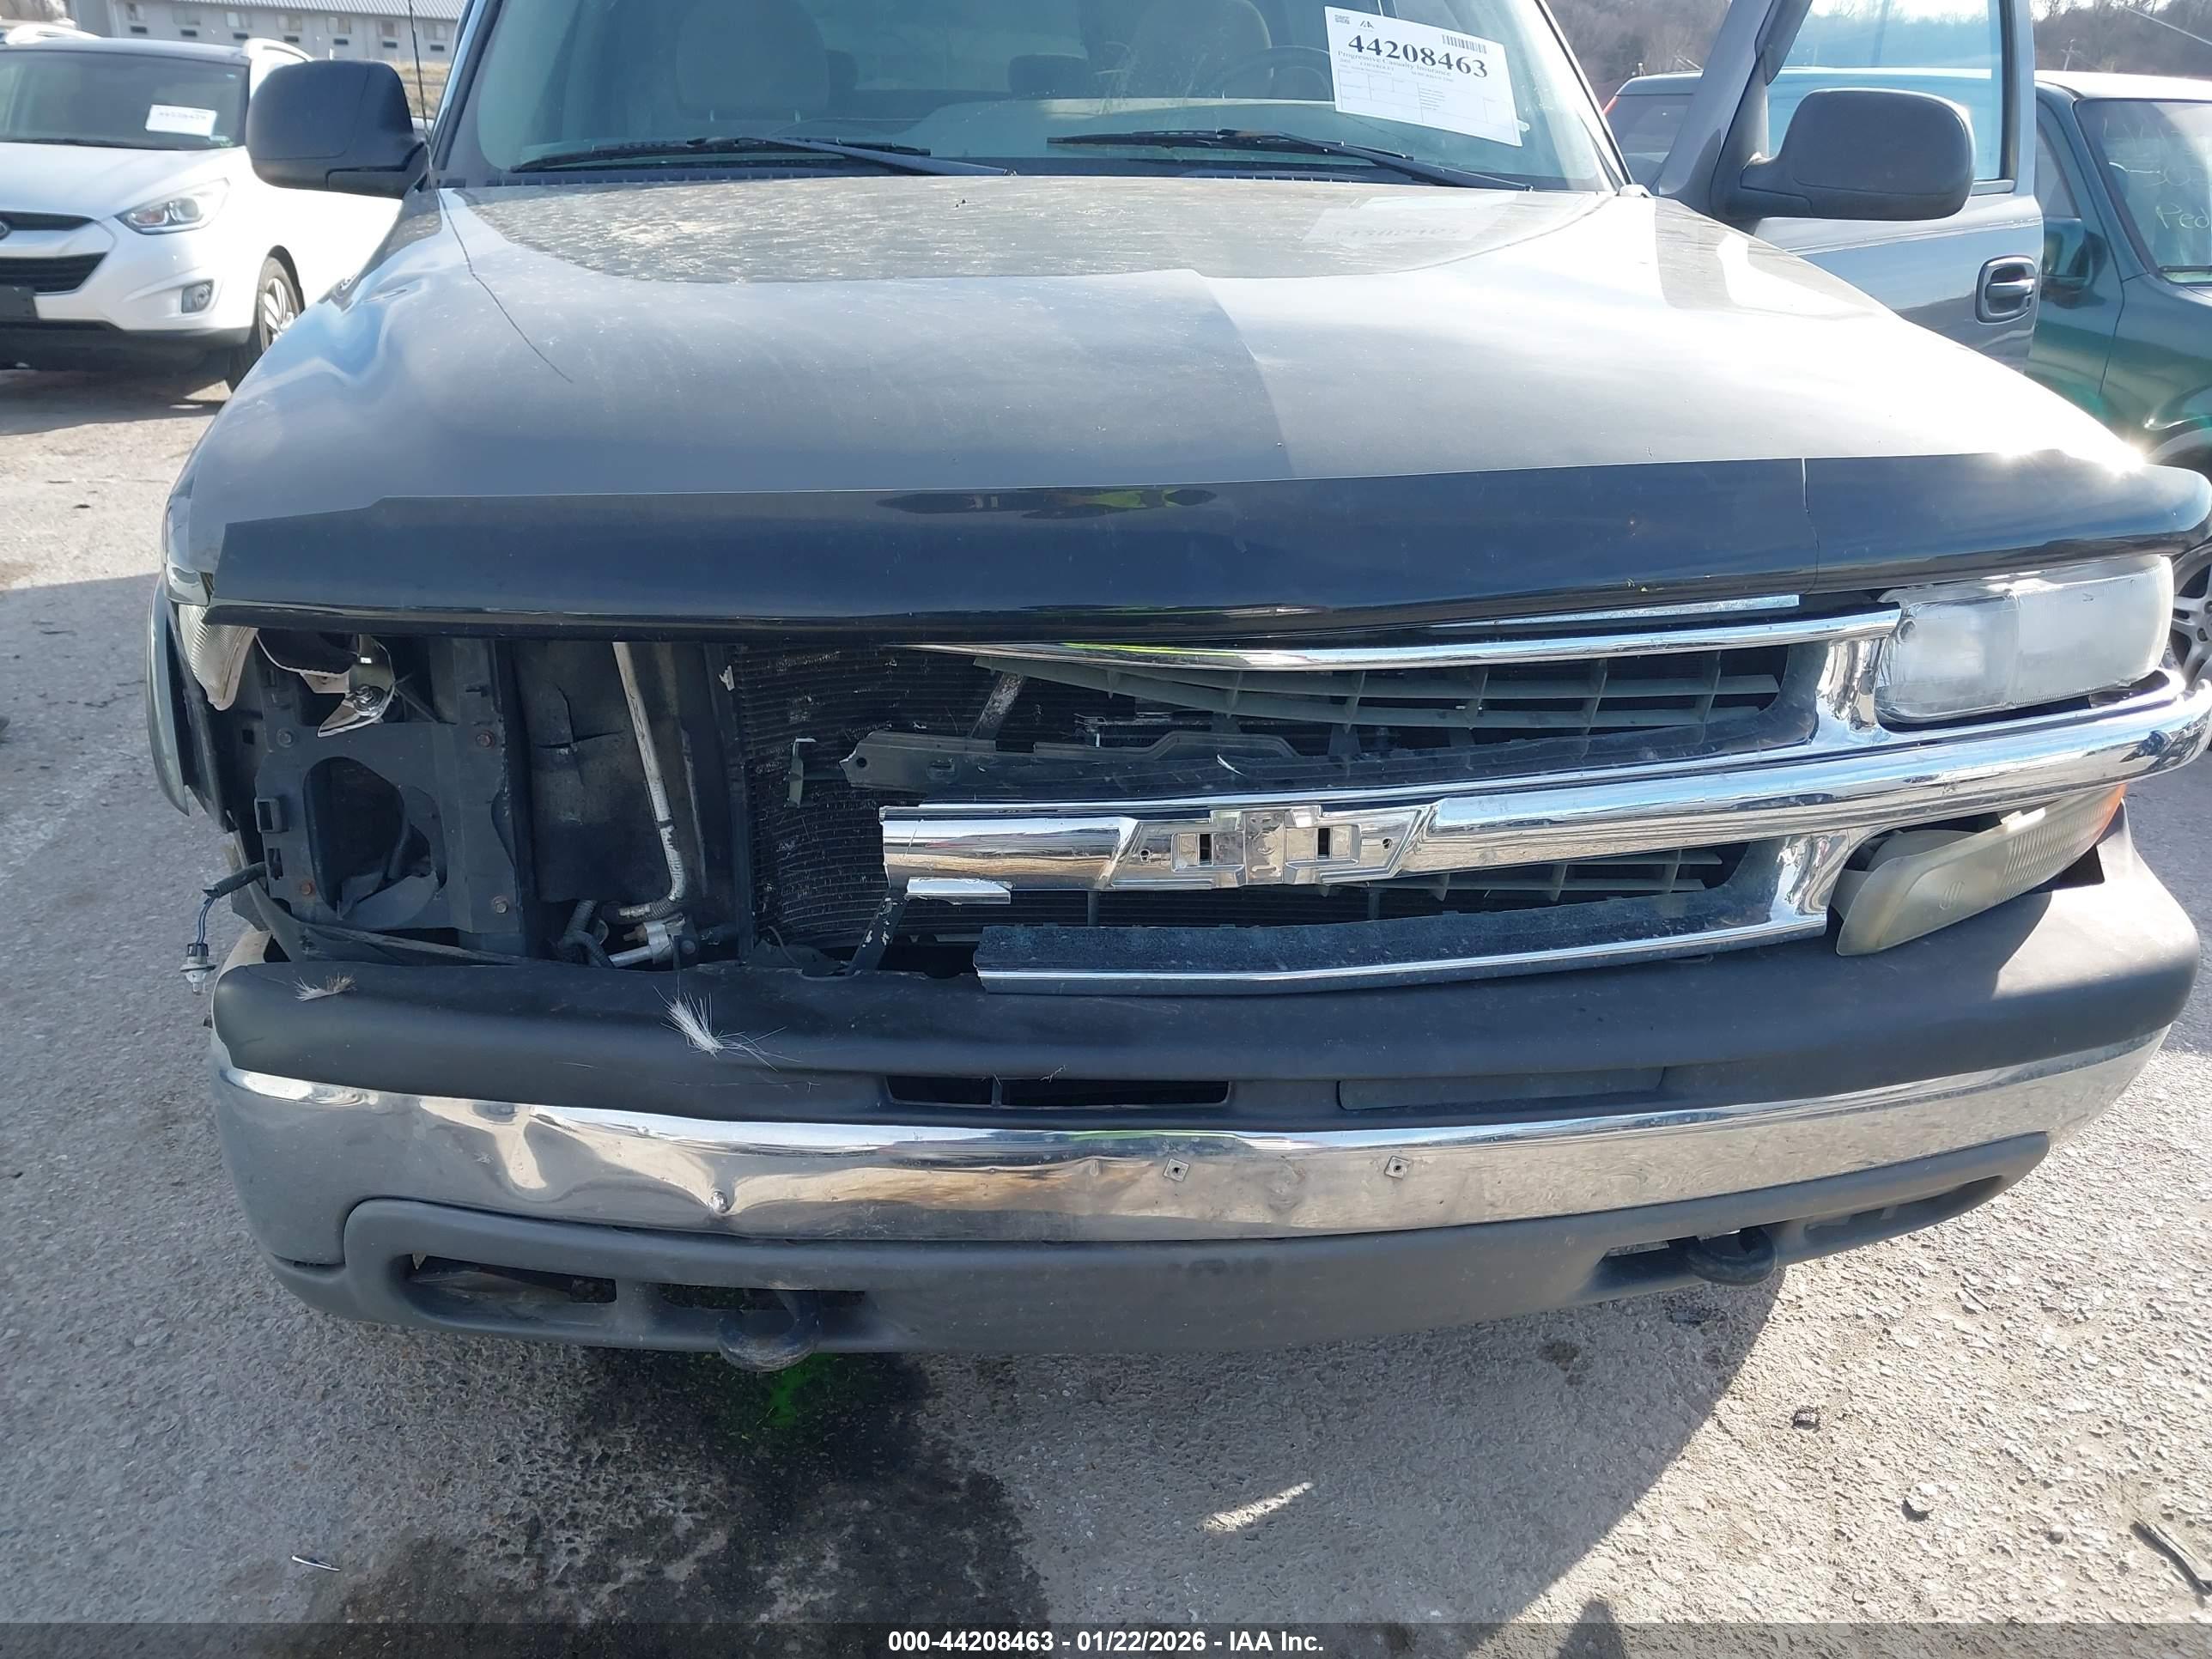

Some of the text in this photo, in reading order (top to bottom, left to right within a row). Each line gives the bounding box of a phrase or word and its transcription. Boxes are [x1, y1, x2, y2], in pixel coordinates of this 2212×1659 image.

[1338, 51, 1382, 64] Progressive
[1417, 64, 1451, 76] Insurance
[1348, 34, 1488, 78] 44208463
